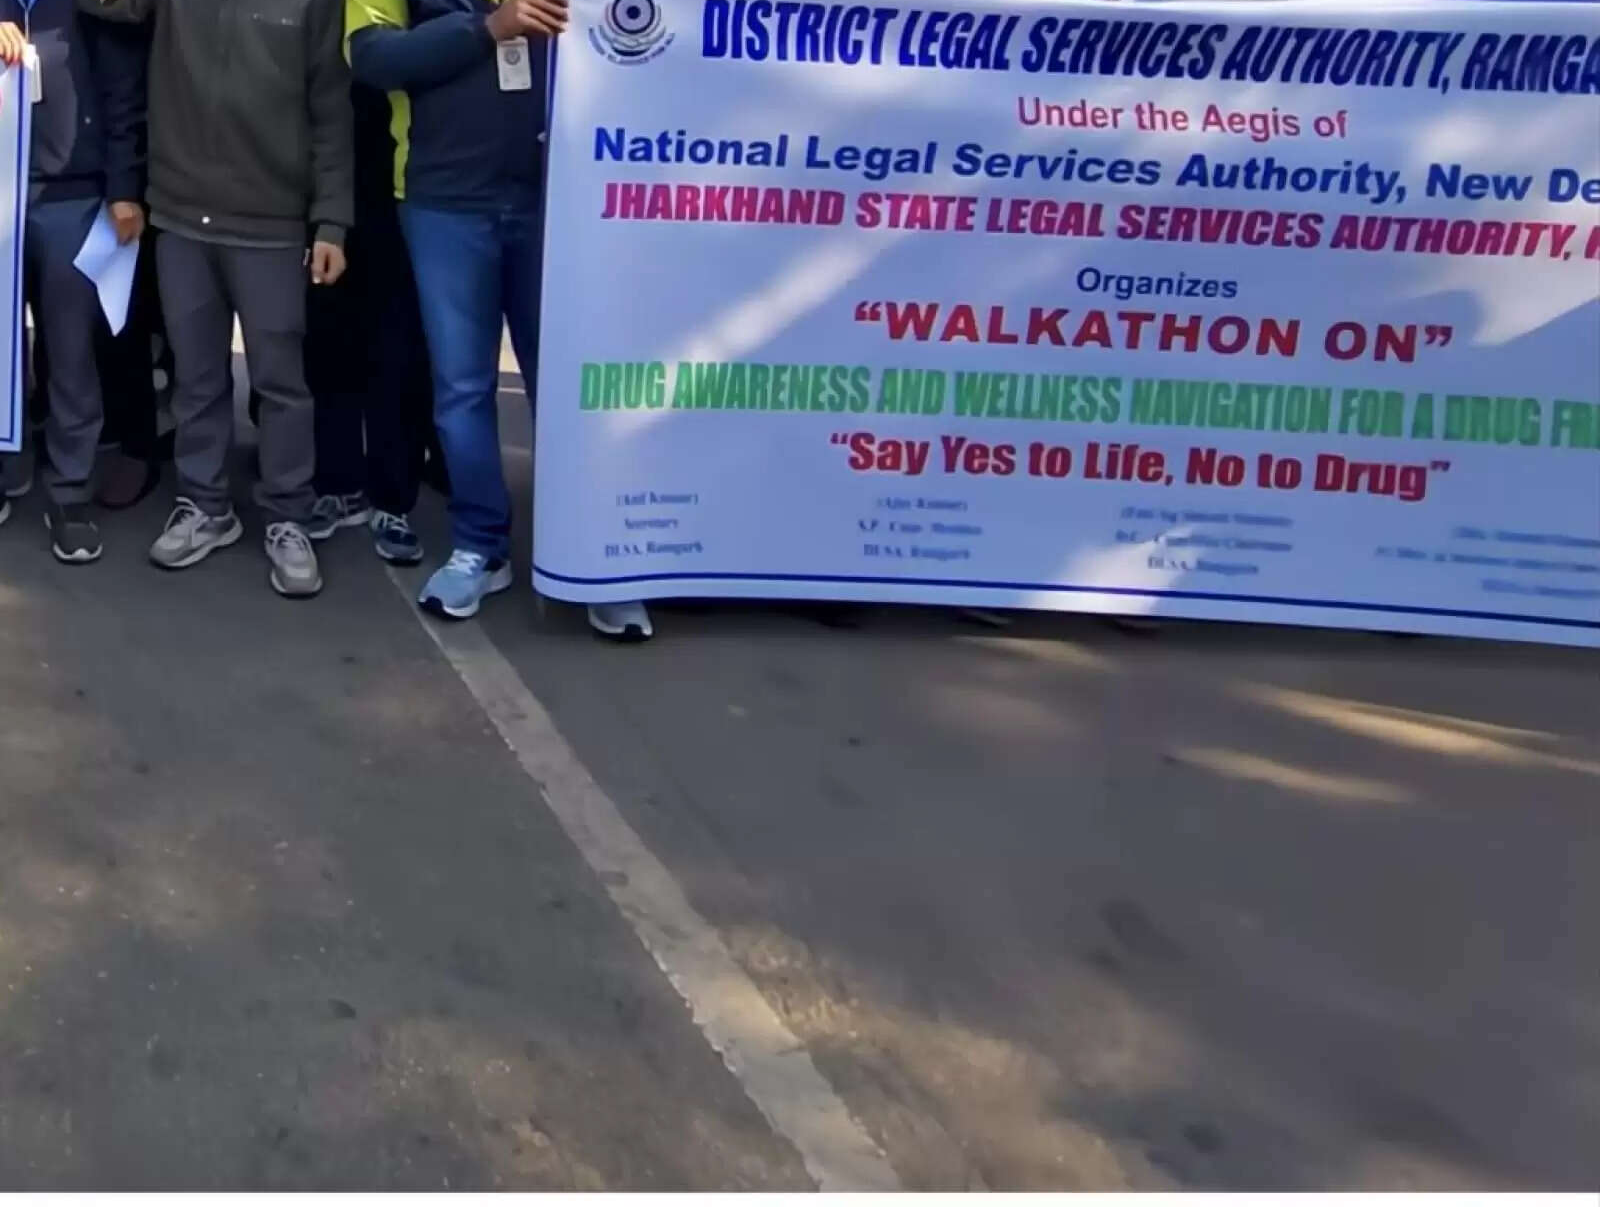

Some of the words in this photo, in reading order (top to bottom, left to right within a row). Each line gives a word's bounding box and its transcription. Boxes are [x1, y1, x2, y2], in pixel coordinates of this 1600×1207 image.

[899, 10, 1022, 71] LEGAL
[1020, 15, 1229, 80] SERVICES
[1220, 24, 1466, 95] AUTHORITY,
[1018, 96, 1123, 129] Under
[1135, 102, 1188, 131] the
[1202, 104, 1300, 142] Aegis
[1314, 110, 1349, 138] of
[594, 127, 787, 168] National
[806, 135, 936, 180] Legal
[952, 142, 1161, 186] Services
[1176, 153, 1406, 204] Authority,
[1425, 163, 1532, 202] New
[601, 182, 844, 226] JHARKHAND
[855, 193, 976, 231] STATE
[986, 198, 1105, 238] LEGAL
[1117, 204, 1324, 249] SERVICES
[1329, 215, 1576, 261] AUTHORITY,
[1076, 267, 1238, 300] Organizes
[580, 362, 667, 411] DRUG
[672, 362, 870, 413] AWARENESS
[877, 367, 945, 416] AND
[954, 371, 1122, 423] WELLNESS
[1129, 378, 1332, 434] NAVIGATION
[1339, 388, 1405, 438] FOR
[1411, 393, 1434, 439] A
[1443, 395, 1541, 445] DRUG
[940, 435, 1016, 476] Yes
[1027, 441, 1072, 478] to
[1084, 442, 1173, 486] Life,
[1185, 447, 1245, 487] No
[1257, 453, 1301, 490] to
